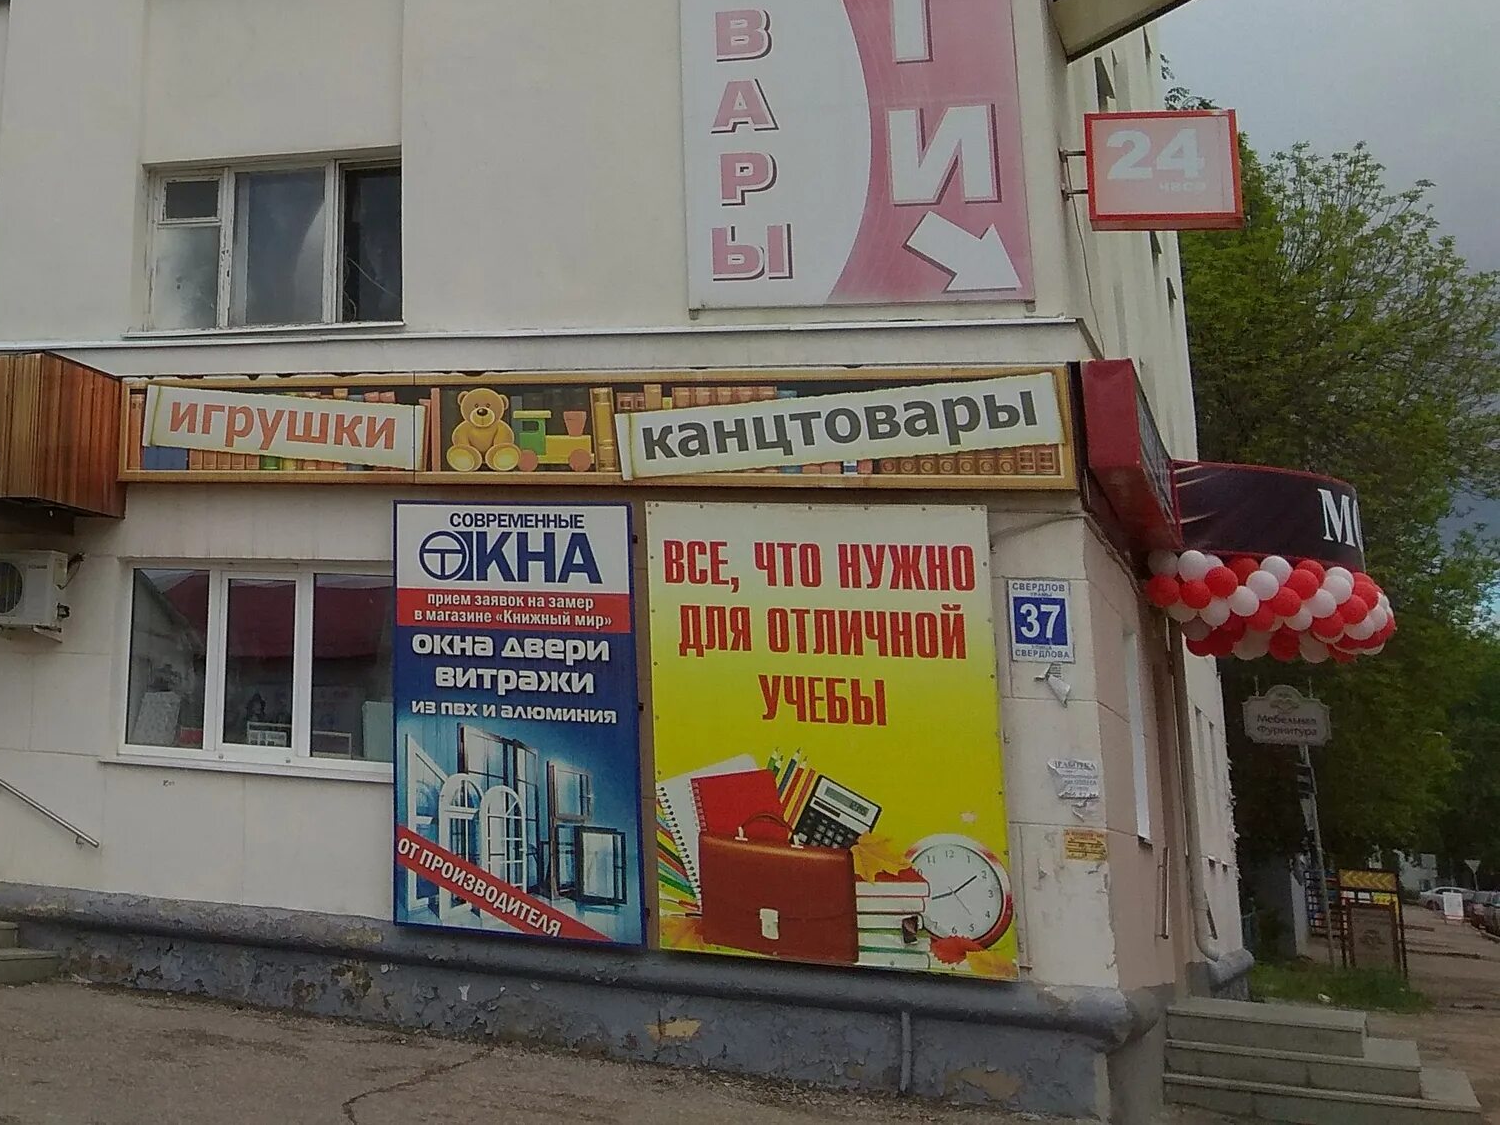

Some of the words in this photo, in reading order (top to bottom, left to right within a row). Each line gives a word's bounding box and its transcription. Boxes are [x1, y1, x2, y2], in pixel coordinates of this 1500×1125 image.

[1106, 128, 1205, 180] 24
[169, 401, 396, 450] игрушки
[642, 390, 1038, 461] канцтовары
[449, 512, 585, 529] СОВРЕМЕННЫЕ
[662, 539, 740, 593] ВСЕ,
[754, 541, 822, 588] ЧТО
[837, 543, 976, 591] НУЖНО
[1012, 582, 1065, 592] СВЕРДЛОВ
[427, 592, 471, 610] прием
[474, 593, 525, 607] заявок
[528, 595, 545, 607] на
[548, 596, 594, 614] замер
[415, 610, 422, 620] в
[426, 610, 492, 622] магазине
[495, 609, 570, 625] «Книжный
[574, 614, 612, 629] мир»
[1020, 603, 1061, 639] 37
[678, 604, 752, 658] ДЛЯ
[767, 603, 967, 660] ОТЛИЧНОЙ
[412, 633, 494, 657] окна
[501, 637, 610, 666] двери
[1015, 649, 1070, 659] СВЕРДЛОВА
[435, 666, 595, 696] витражи
[758, 674, 888, 726] УЧЕБЫ
[411, 700, 436, 714] из
[483, 704, 496, 718] и
[501, 705, 617, 724] алюминия
[927, 855, 936, 864] 11
[945, 849, 955, 859] 12
[981, 870, 987, 879] 2
[398, 838, 420, 860] ОТ
[418, 849, 562, 938] ПРОИЗВОДИТЕЛЯ
[988, 890, 994, 898] 3
[985, 911, 990, 919] 4
[951, 926, 957, 934] 6
[969, 923, 975, 932] 5
